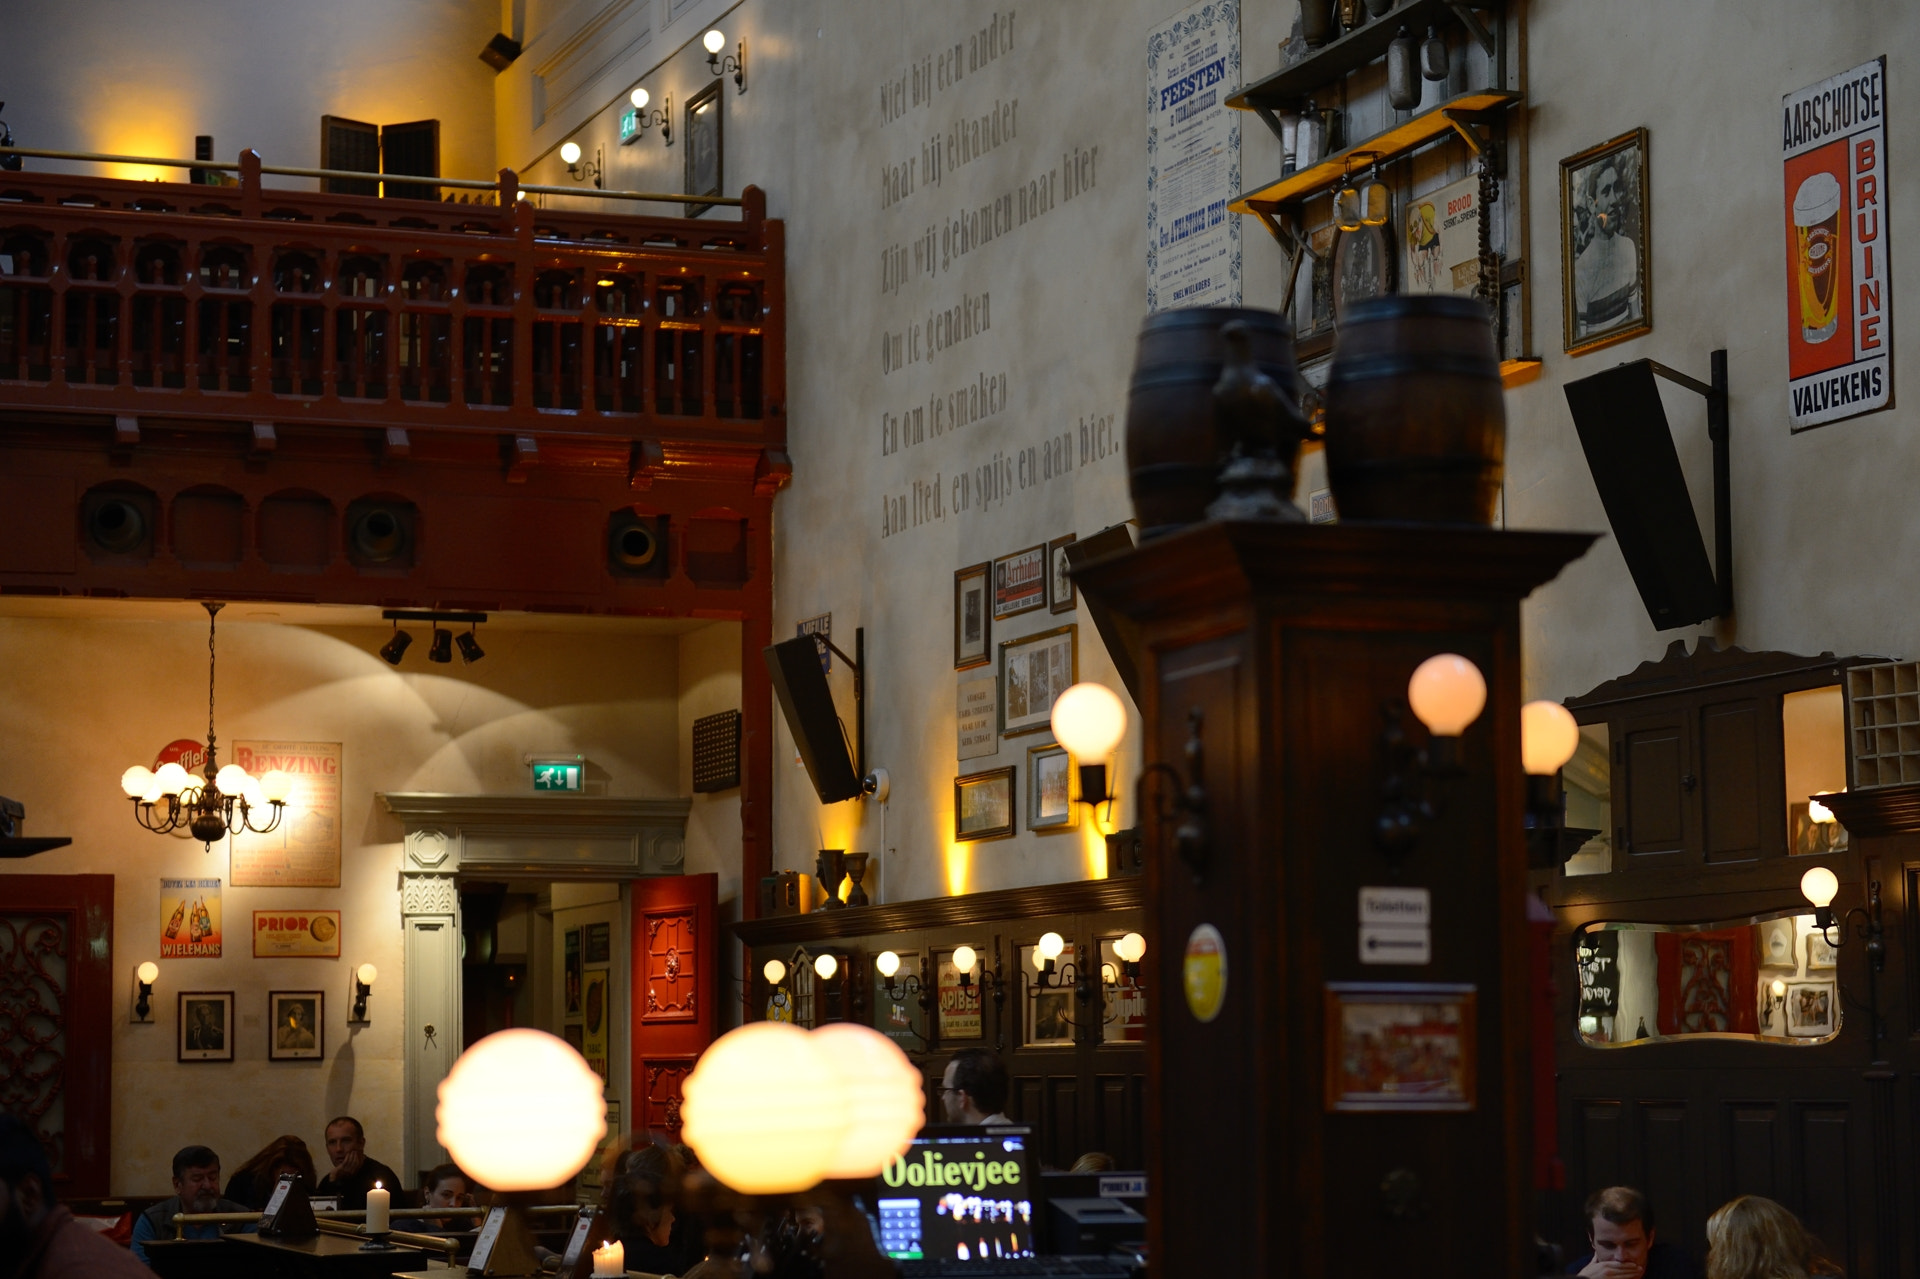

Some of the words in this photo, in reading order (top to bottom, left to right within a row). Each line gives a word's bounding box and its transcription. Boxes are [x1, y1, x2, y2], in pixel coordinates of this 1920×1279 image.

[912, 54, 932, 108] bij
[937, 43, 963, 91] een
[969, 9, 1016, 74] ander
[1161, 56, 1226, 111] FEESTEN
[1783, 71, 1880, 152] AARSCHOTSE
[881, 156, 916, 210] Maar
[922, 133, 942, 188] bij
[947, 98, 1018, 172] elkander
[881, 243, 909, 296] Zijn
[914, 224, 937, 279] wij
[942, 191, 1012, 273] gekomen
[1018, 168, 1056, 227] naar
[1447, 193, 1472, 216] BROOD
[1855, 139, 1881, 350] BRUINE
[882, 331, 902, 375] Om
[907, 320, 920, 364] te
[882, 412, 898, 456] En
[903, 405, 924, 449] om
[929, 392, 943, 439] te
[949, 371, 1007, 432] smaken
[1793, 365, 1882, 418] VALVEKENS
[882, 494, 907, 539] Aan
[912, 472, 946, 527] lied,
[953, 470, 970, 515] en
[975, 451, 1012, 513] spijs
[1018, 446, 1036, 490] en
[1043, 431, 1073, 481] aan
[1079, 411, 1119, 467] bier.
[237, 746, 337, 775] BENZING
[162, 943, 221, 956] WIELEMANS
[258, 917, 308, 931] PRIOR
[941, 989, 979, 1012] APIBEL
[882, 1150, 1021, 1192] Oolievjee
